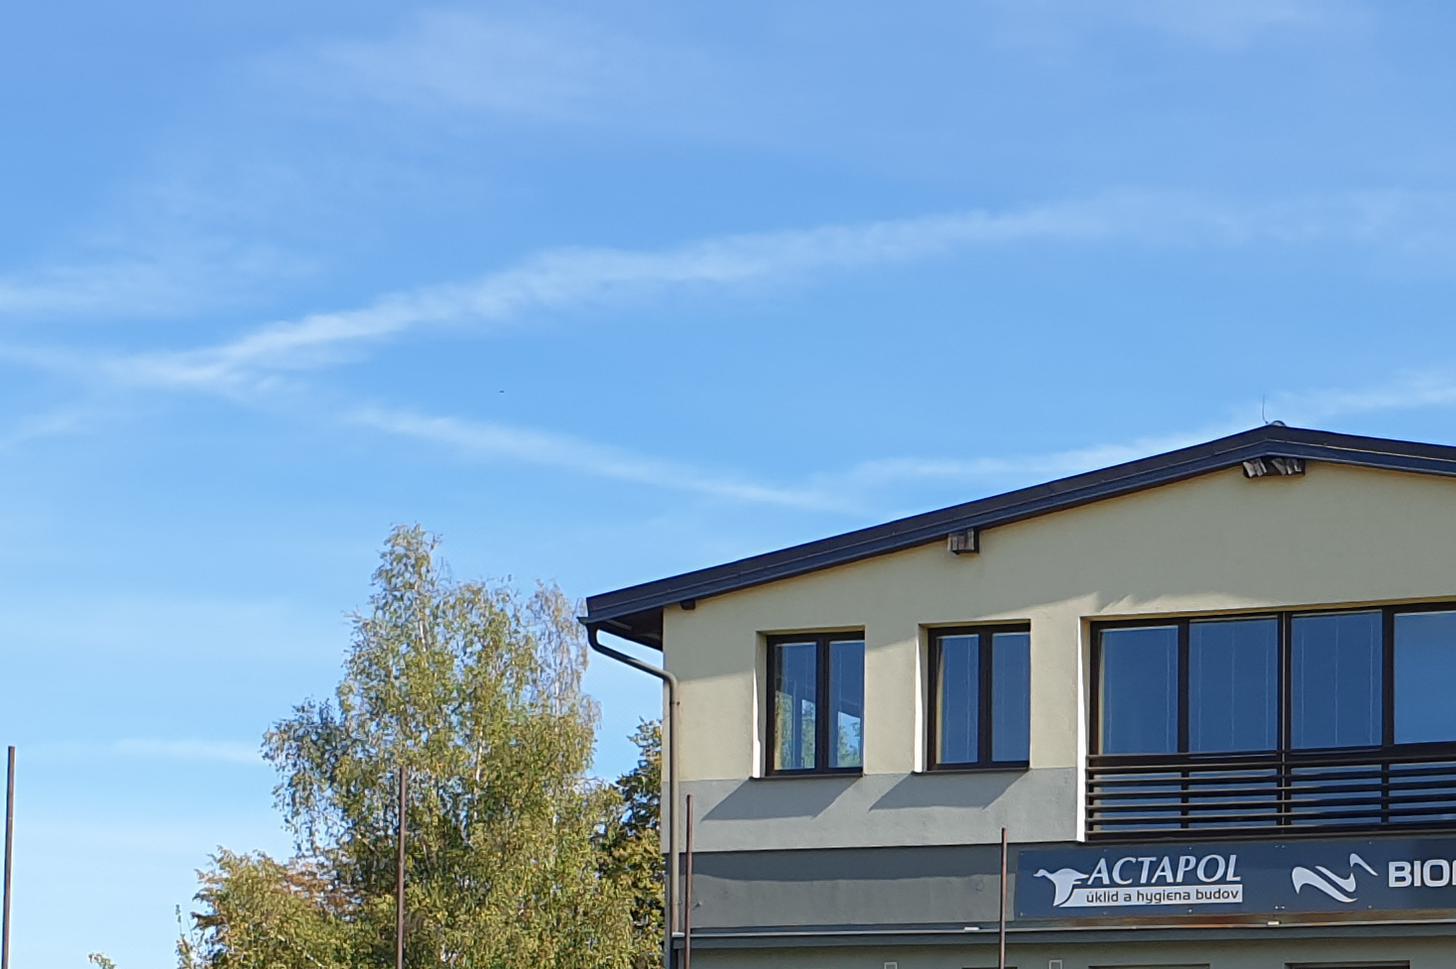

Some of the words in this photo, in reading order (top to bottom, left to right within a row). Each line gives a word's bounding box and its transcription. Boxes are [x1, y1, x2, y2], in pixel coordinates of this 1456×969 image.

[1087, 854, 1242, 886] ACTAPOL
[1086, 890, 1119, 903] úklid
[1123, 892, 1132, 902] a
[1137, 889, 1191, 904] hygiena
[1196, 888, 1239, 900] budov
